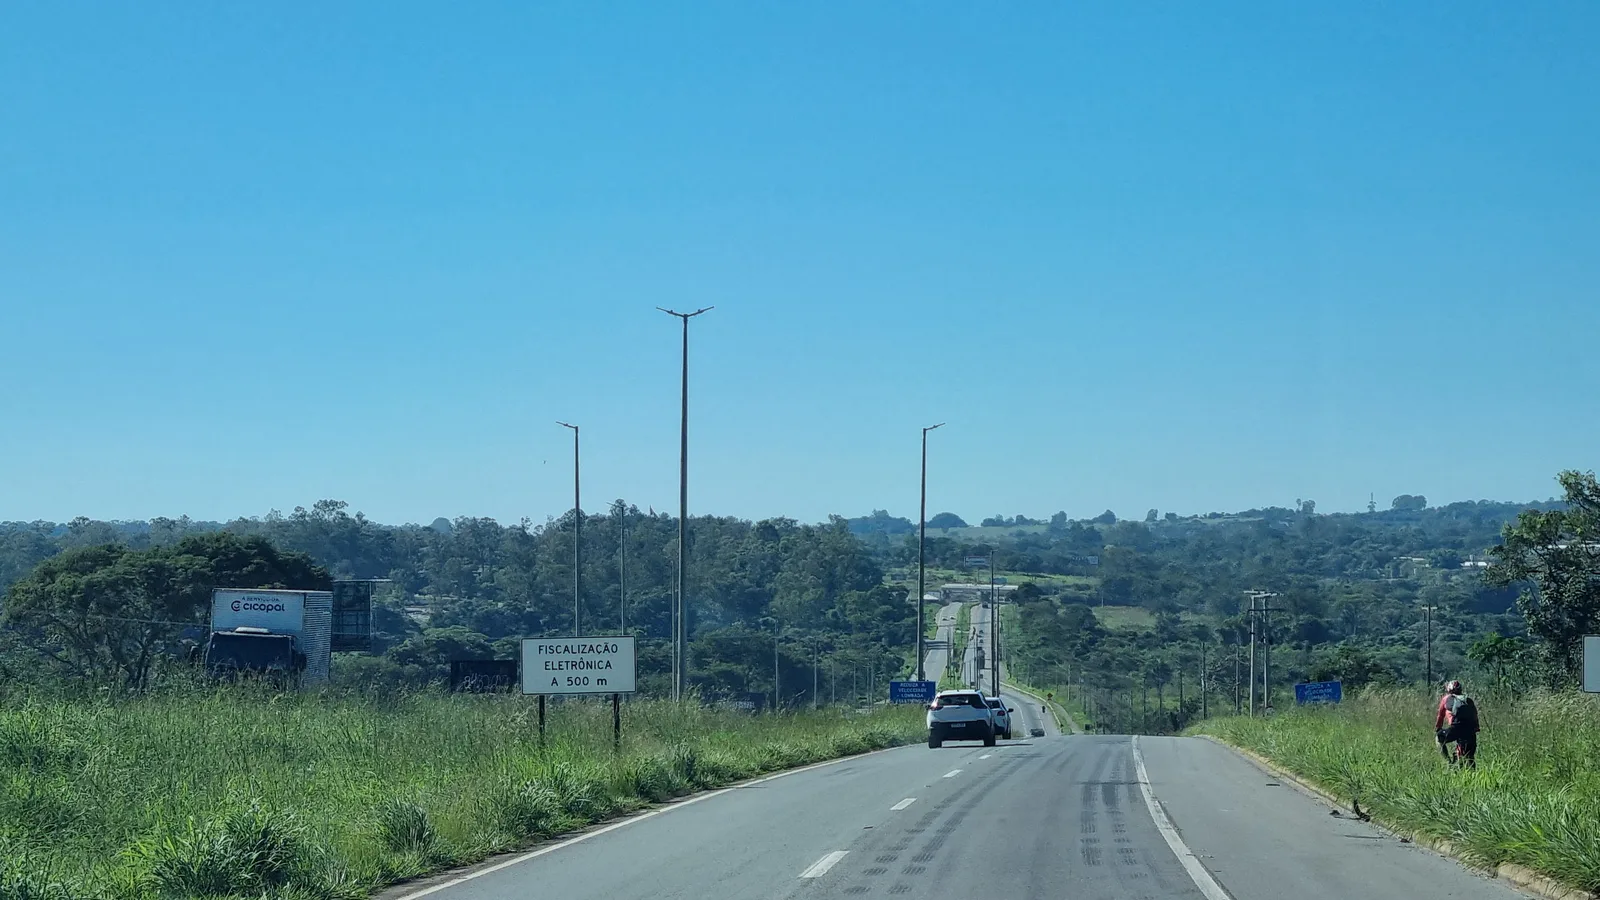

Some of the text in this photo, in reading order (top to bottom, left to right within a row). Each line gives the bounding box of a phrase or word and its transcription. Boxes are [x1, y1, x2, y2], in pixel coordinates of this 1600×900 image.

[538, 642, 618, 655] FISCALIZAÇÃO
[544, 657, 612, 671] ELETRÔNICA
[551, 676, 607, 686] A 500 m
